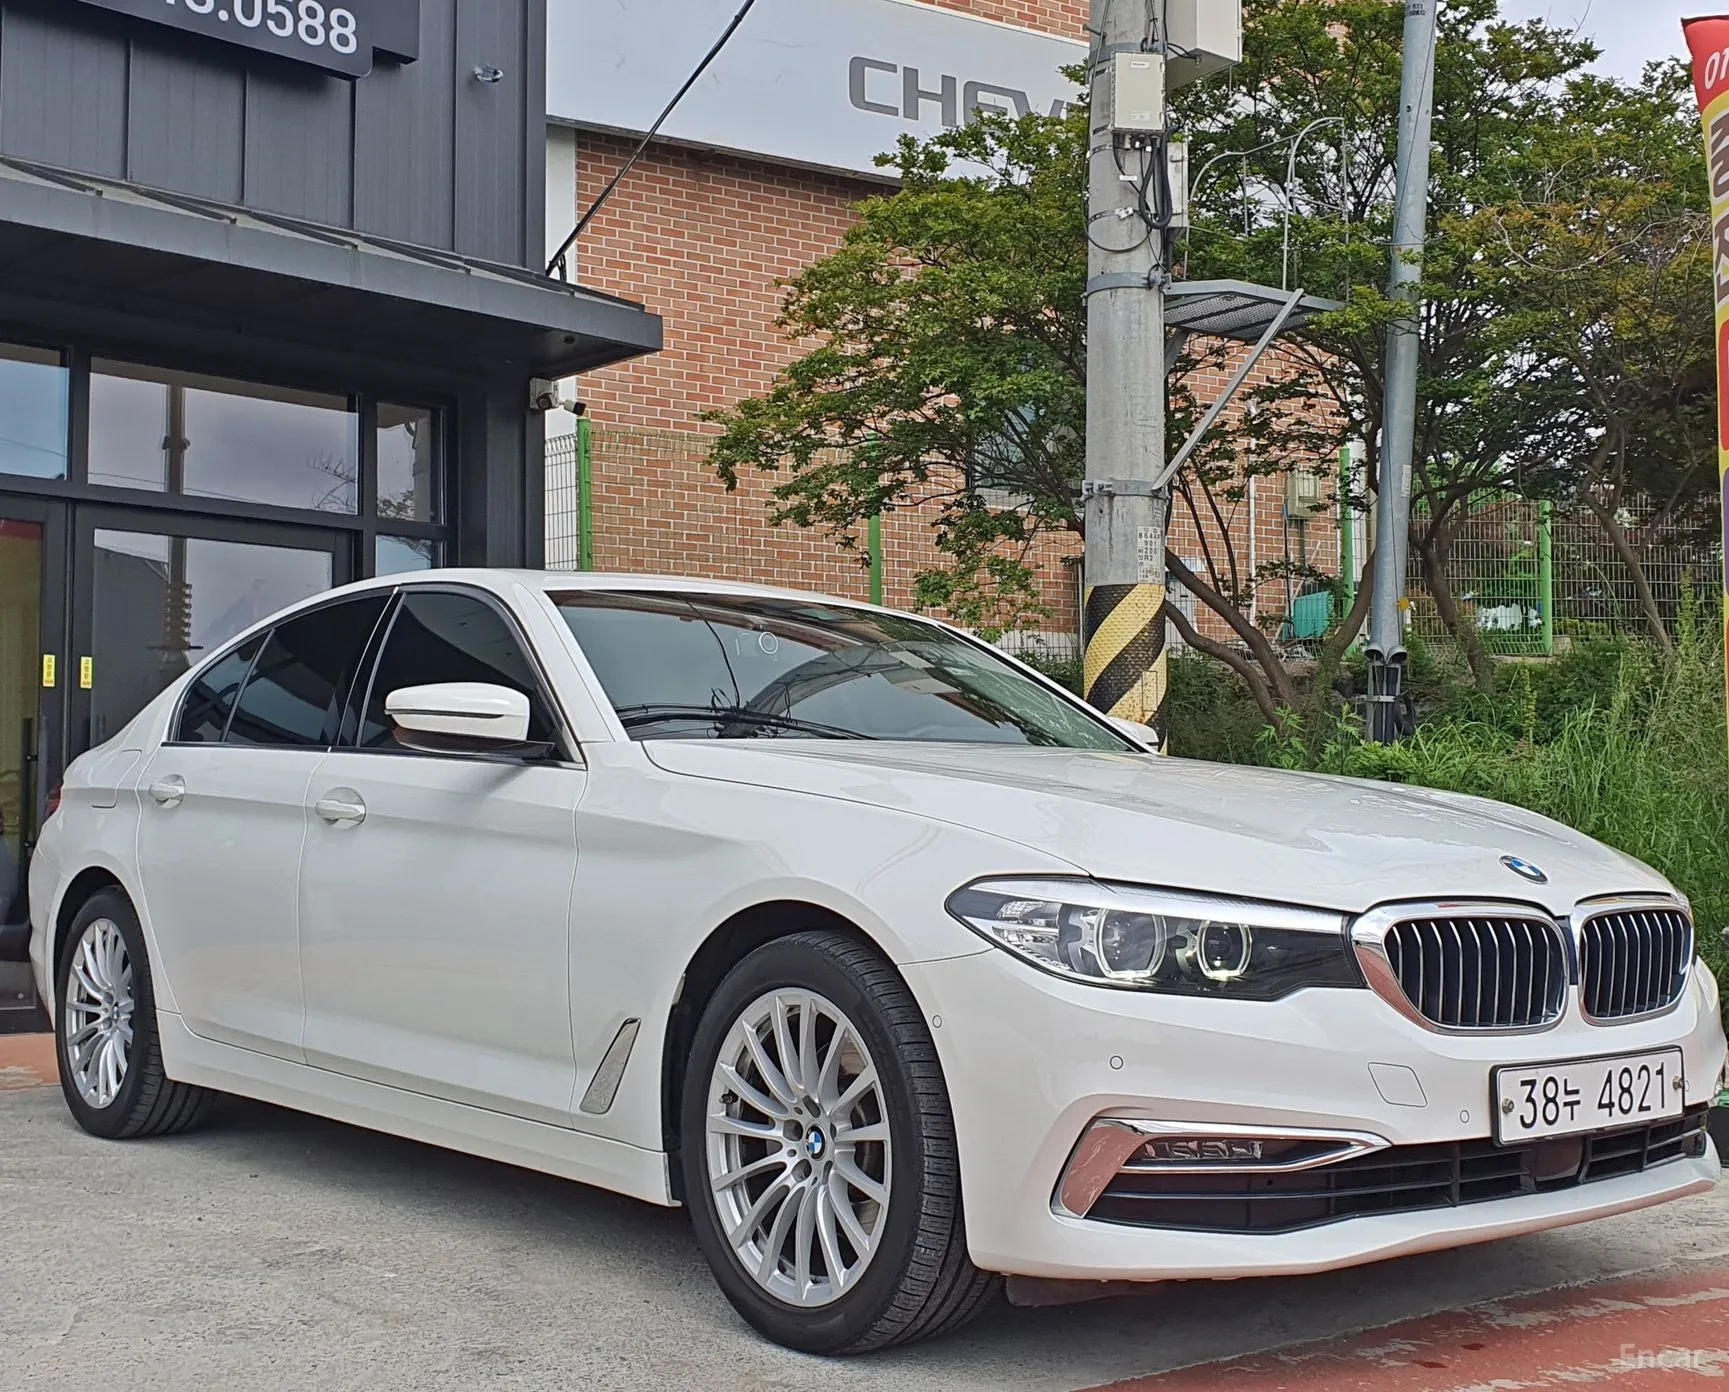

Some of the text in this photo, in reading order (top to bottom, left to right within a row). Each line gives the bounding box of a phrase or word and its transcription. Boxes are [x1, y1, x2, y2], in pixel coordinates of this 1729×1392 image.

[166, 0, 358, 54] .0588
[849, 56, 1088, 132] CHEV
[1519, 1061, 1666, 1129] 38누 4821
